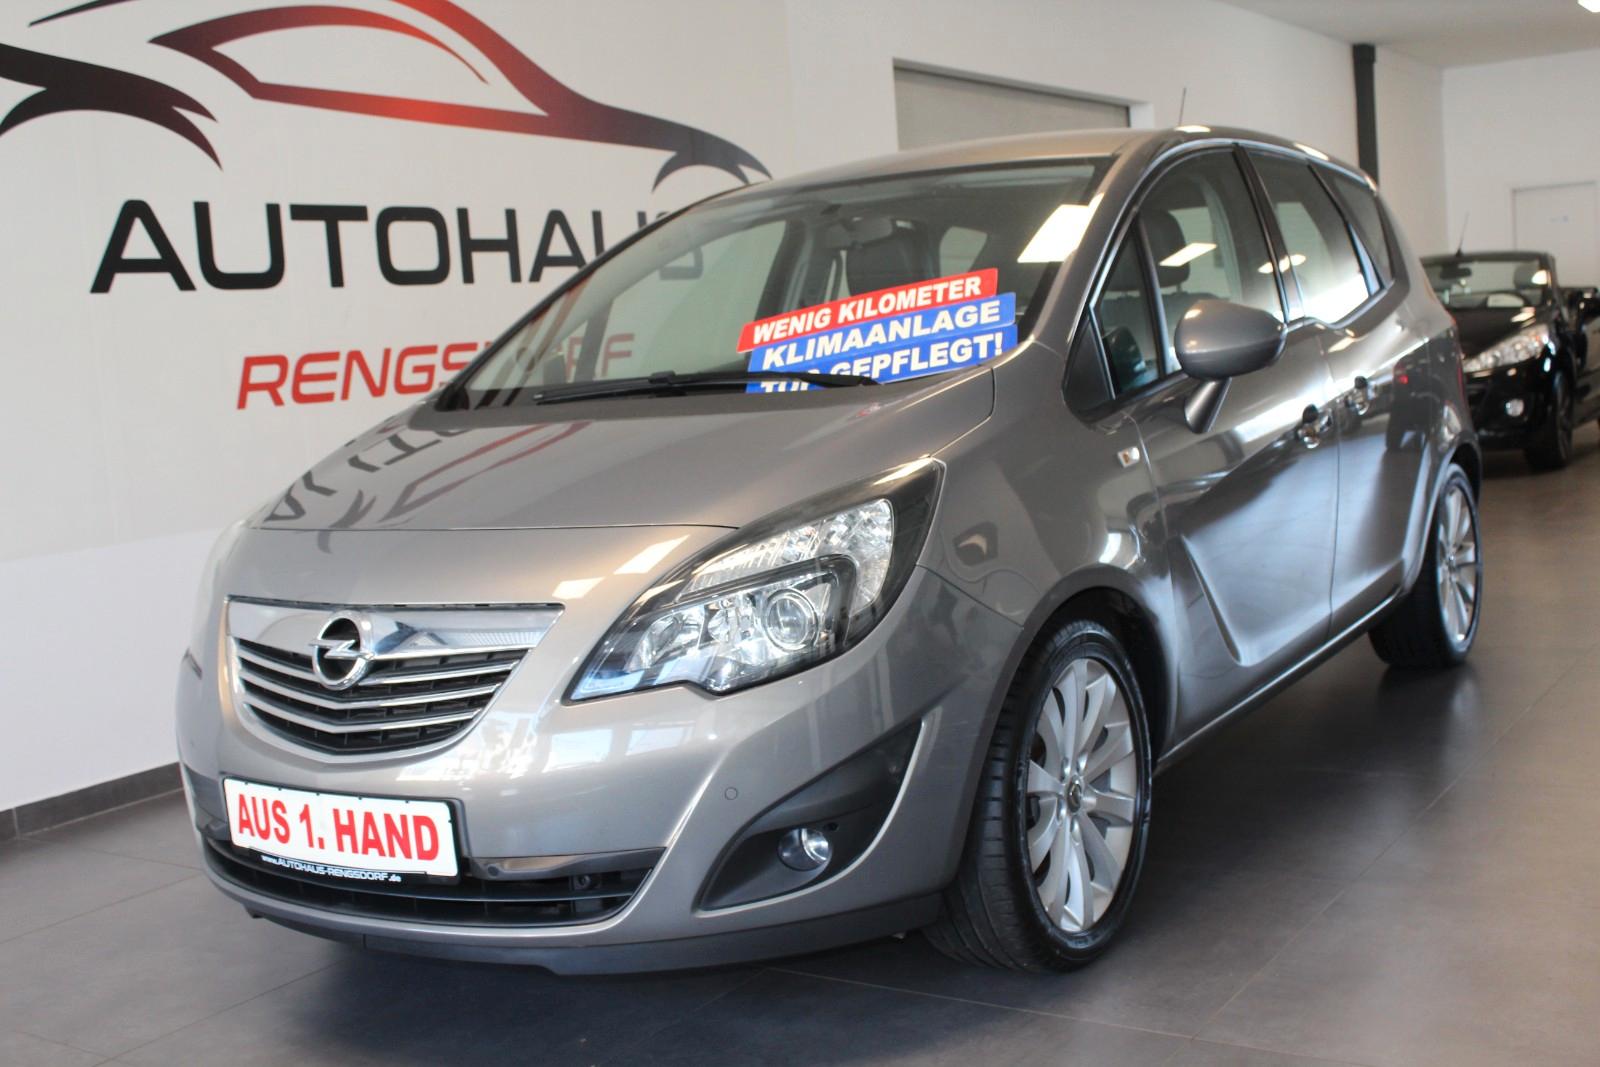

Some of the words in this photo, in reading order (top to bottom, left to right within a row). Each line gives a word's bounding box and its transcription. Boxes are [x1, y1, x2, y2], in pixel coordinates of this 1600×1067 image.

[753, 307, 832, 345] WENIG
[837, 276, 982, 324] KILOMETER
[762, 299, 1001, 371] KLIMAANLAGE
[236, 332, 635, 410] RENGSF
[238, 793, 291, 844] AUS
[298, 803, 325, 849] 1.
[333, 808, 439, 861] HAND
